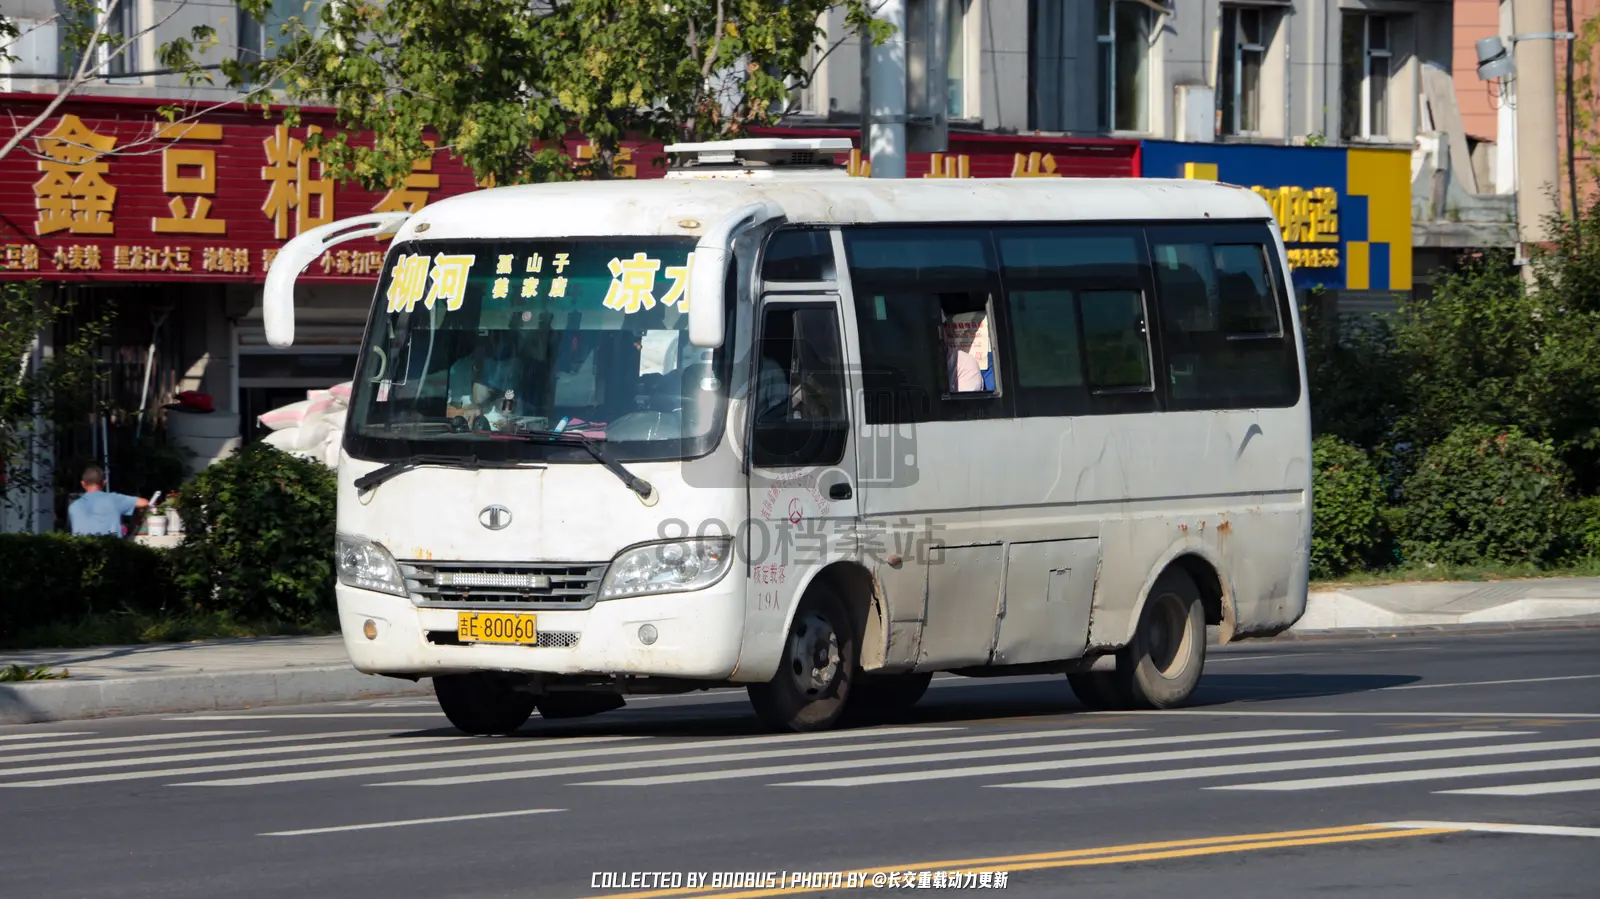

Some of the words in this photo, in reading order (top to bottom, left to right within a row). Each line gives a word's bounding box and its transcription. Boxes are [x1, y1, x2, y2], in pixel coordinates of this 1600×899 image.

[113, 245, 192, 271] 黑龙江大豆
[386, 252, 475, 313] 柳河
[753, 563, 785, 585] 核定载客
[757, 590, 780, 611] 19人
